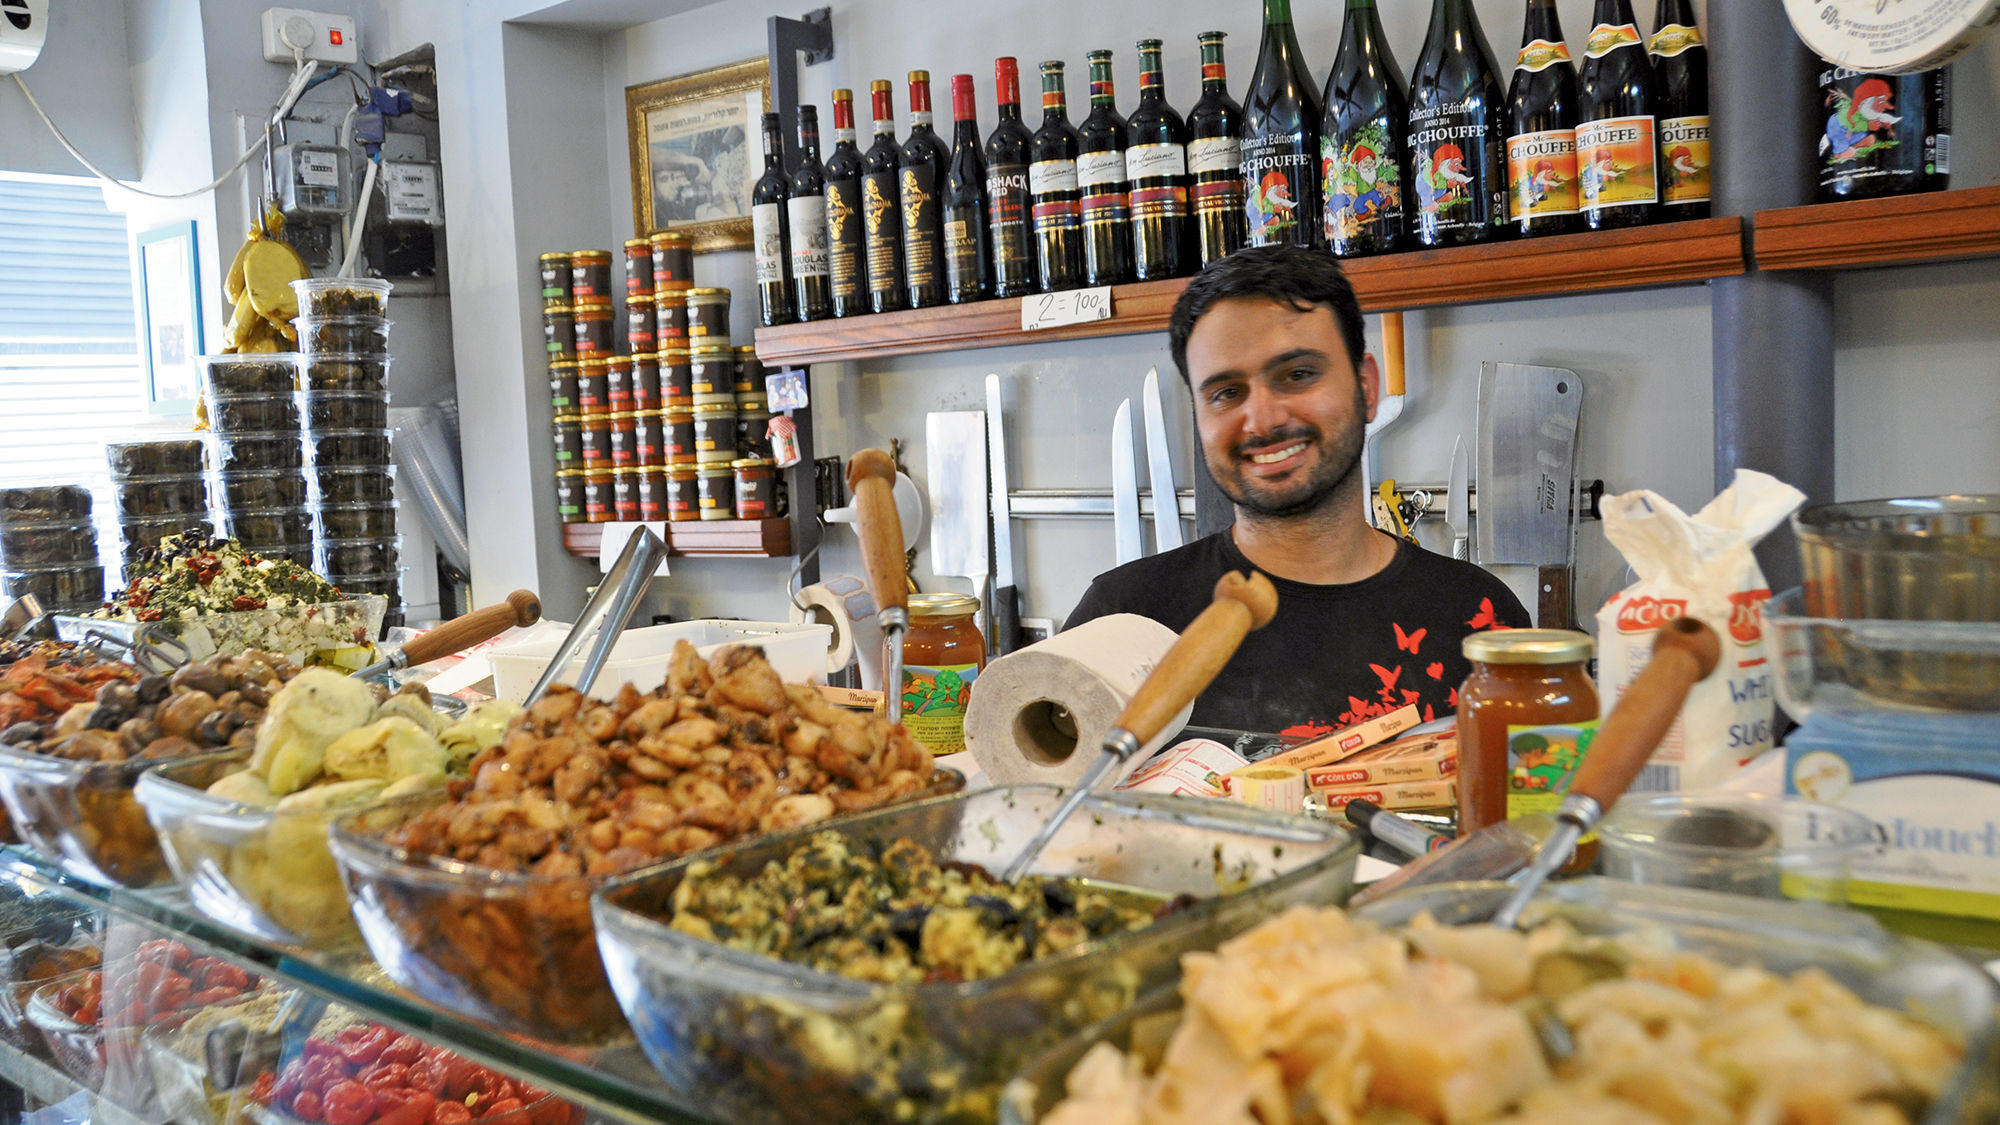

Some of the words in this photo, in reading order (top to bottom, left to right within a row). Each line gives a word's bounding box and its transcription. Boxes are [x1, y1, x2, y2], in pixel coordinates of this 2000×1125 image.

[1821, 5, 1840, 30] 60%
[1442, 101, 1472, 115] Edition
[1417, 125, 1485, 144] CHOUFFE
[1577, 128, 1637, 149] CHOUFFE
[1662, 127, 1710, 142] OUFFE
[1510, 141, 1576, 159] CHOUFFE
[1247, 153, 1309, 171] CHOUFFE
[1038, 293, 1056, 321] 2
[848, 692, 878, 704] Marzipan
[1288, 750, 1326, 766] Marzipan
[1382, 767, 1423, 777] Marzipan
[1398, 789, 1436, 800] Marzipan
